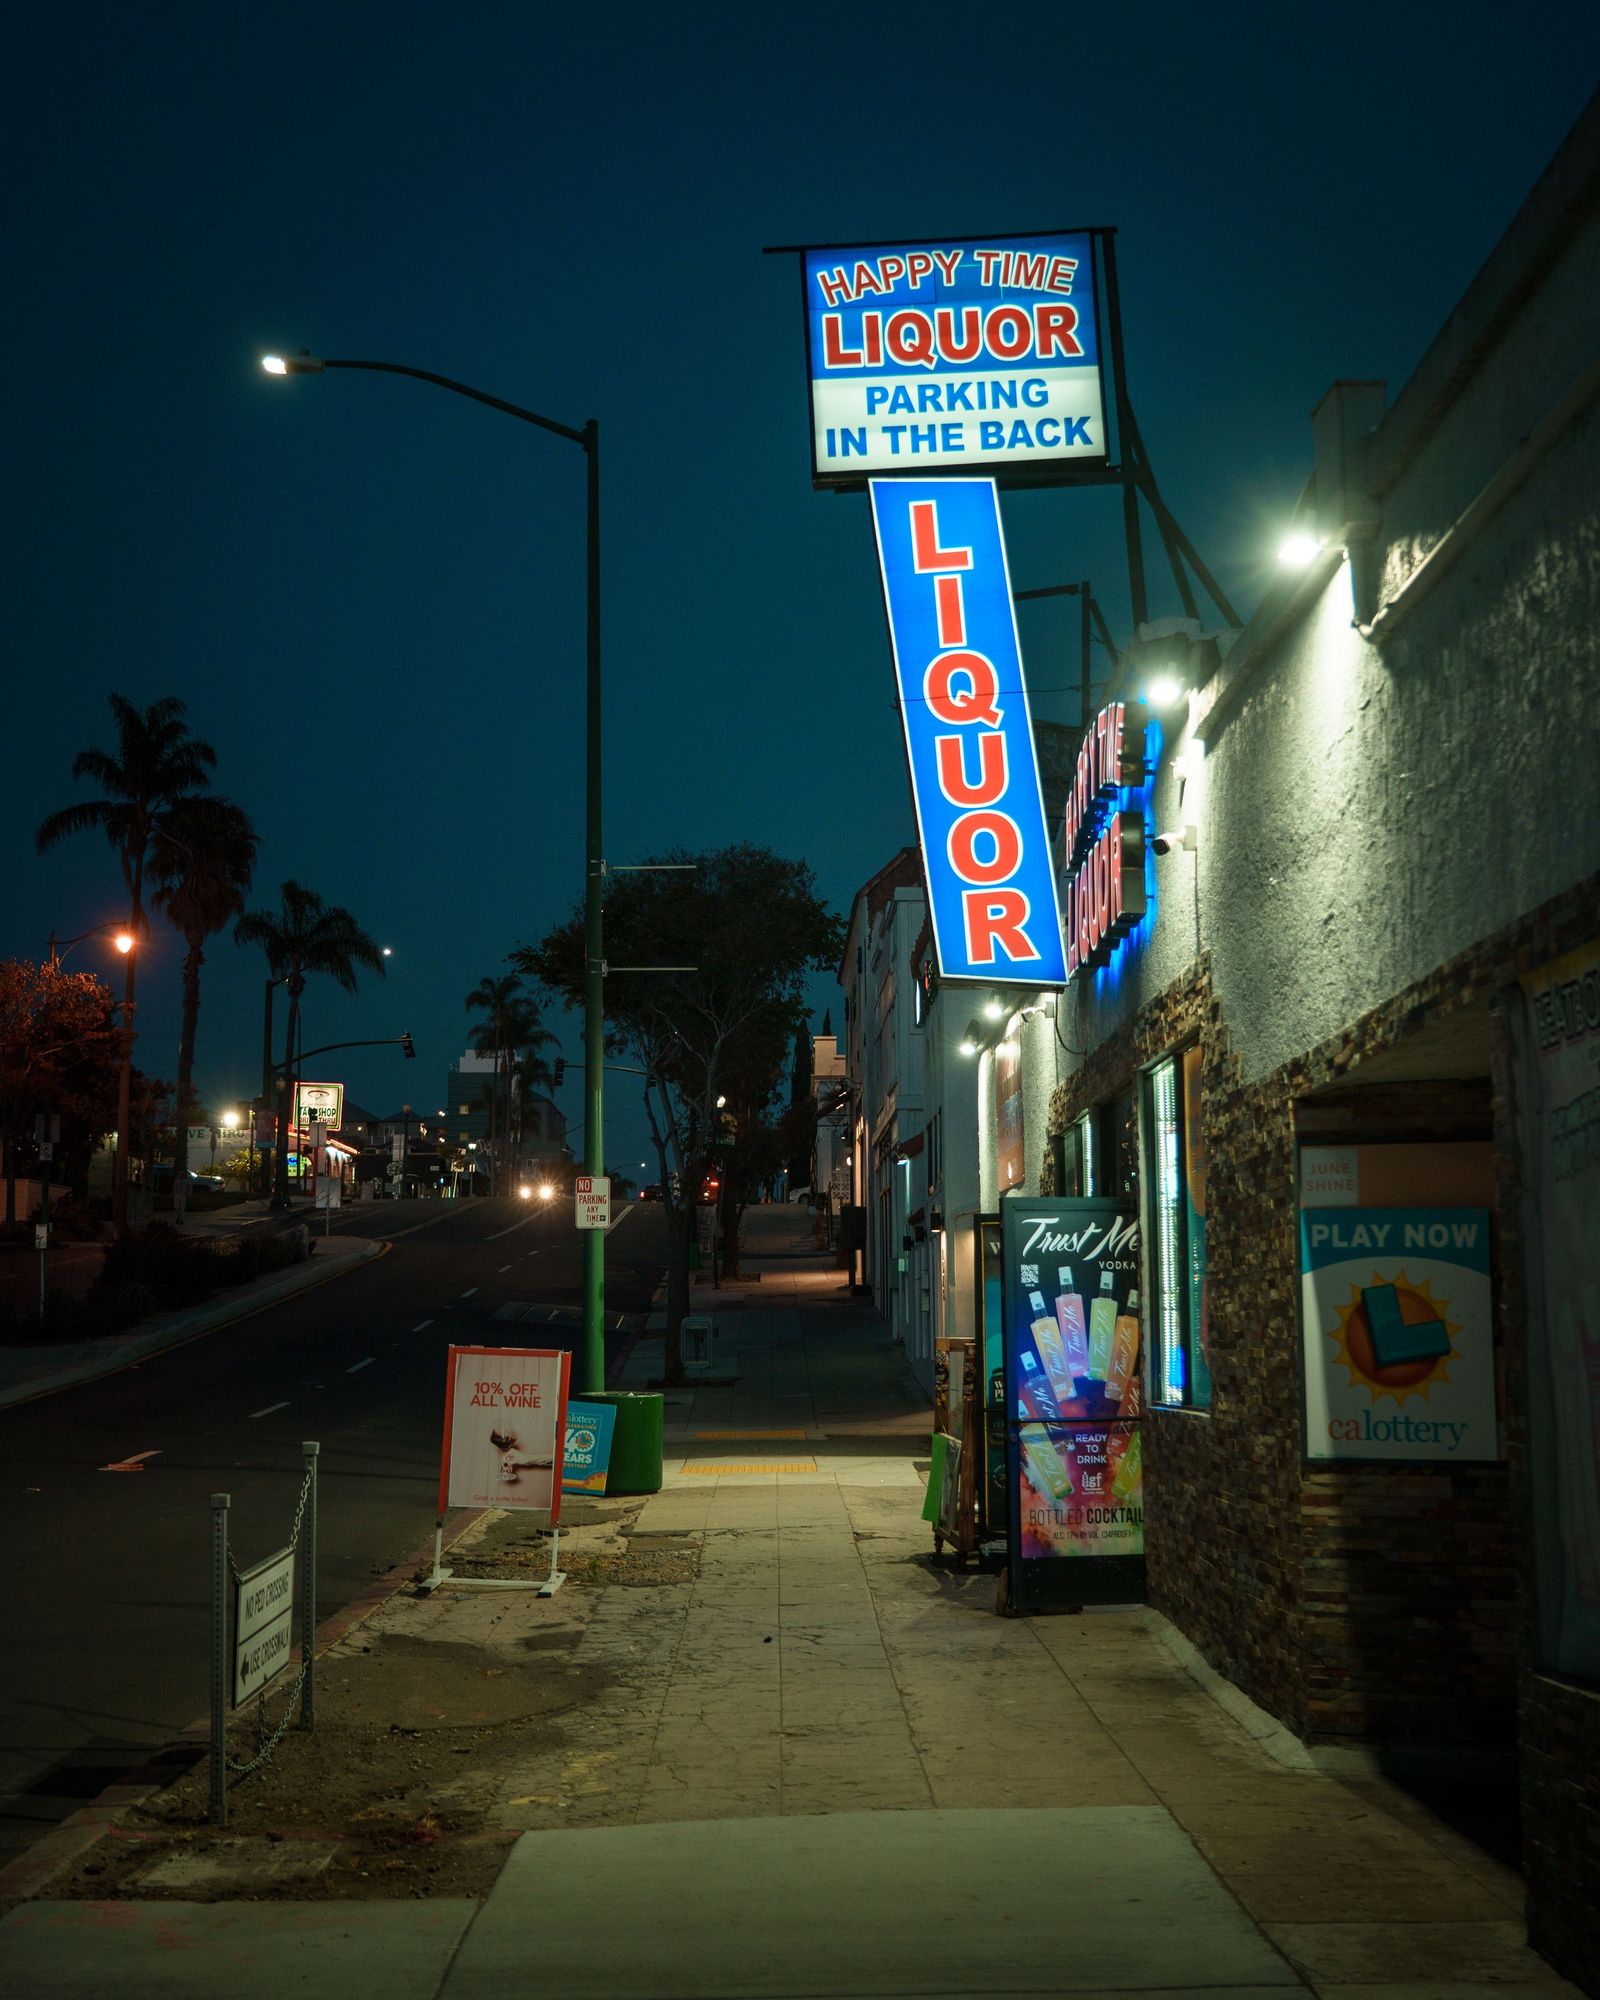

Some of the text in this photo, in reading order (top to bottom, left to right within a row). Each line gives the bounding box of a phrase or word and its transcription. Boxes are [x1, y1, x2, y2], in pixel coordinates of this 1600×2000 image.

[817, 250, 1078, 308] HAPPY TIME
[822, 304, 1084, 370] LIQUOR
[866, 378, 1048, 416] PARKING
[826, 416, 1093, 458] IN THE BACK
[909, 500, 1041, 965] LIQUOR
[1067, 811, 1123, 979] LIQUOR
[319, 1108, 336, 1118] SHOP
[1310, 1162, 1349, 1175] JUNE
[578, 1179, 590, 1191] NO
[1306, 1179, 1354, 1192] SHINE
[579, 1195, 607, 1205] PARKING
[586, 1206, 599, 1214] ANY
[1021, 1217, 1102, 1258] Trust
[1311, 1223, 1479, 1249] PLAY NOW
[1098, 1260, 1137, 1270] VODKA
[474, 1382, 538, 1395] 10% OFF
[470, 1395, 541, 1408] ALL WINE
[1328, 1409, 1468, 1451] calottery
[1075, 1433, 1108, 1443] READY
[1086, 1444, 1099, 1453] TO
[563, 1452, 592, 1464] EARS
[1077, 1455, 1108, 1464] DRINK
[1029, 1508, 1083, 1526] BOTTLED
[245, 1573, 289, 1622] NO PED CROSSING
[250, 1625, 290, 1673] USE CROSSWALK
